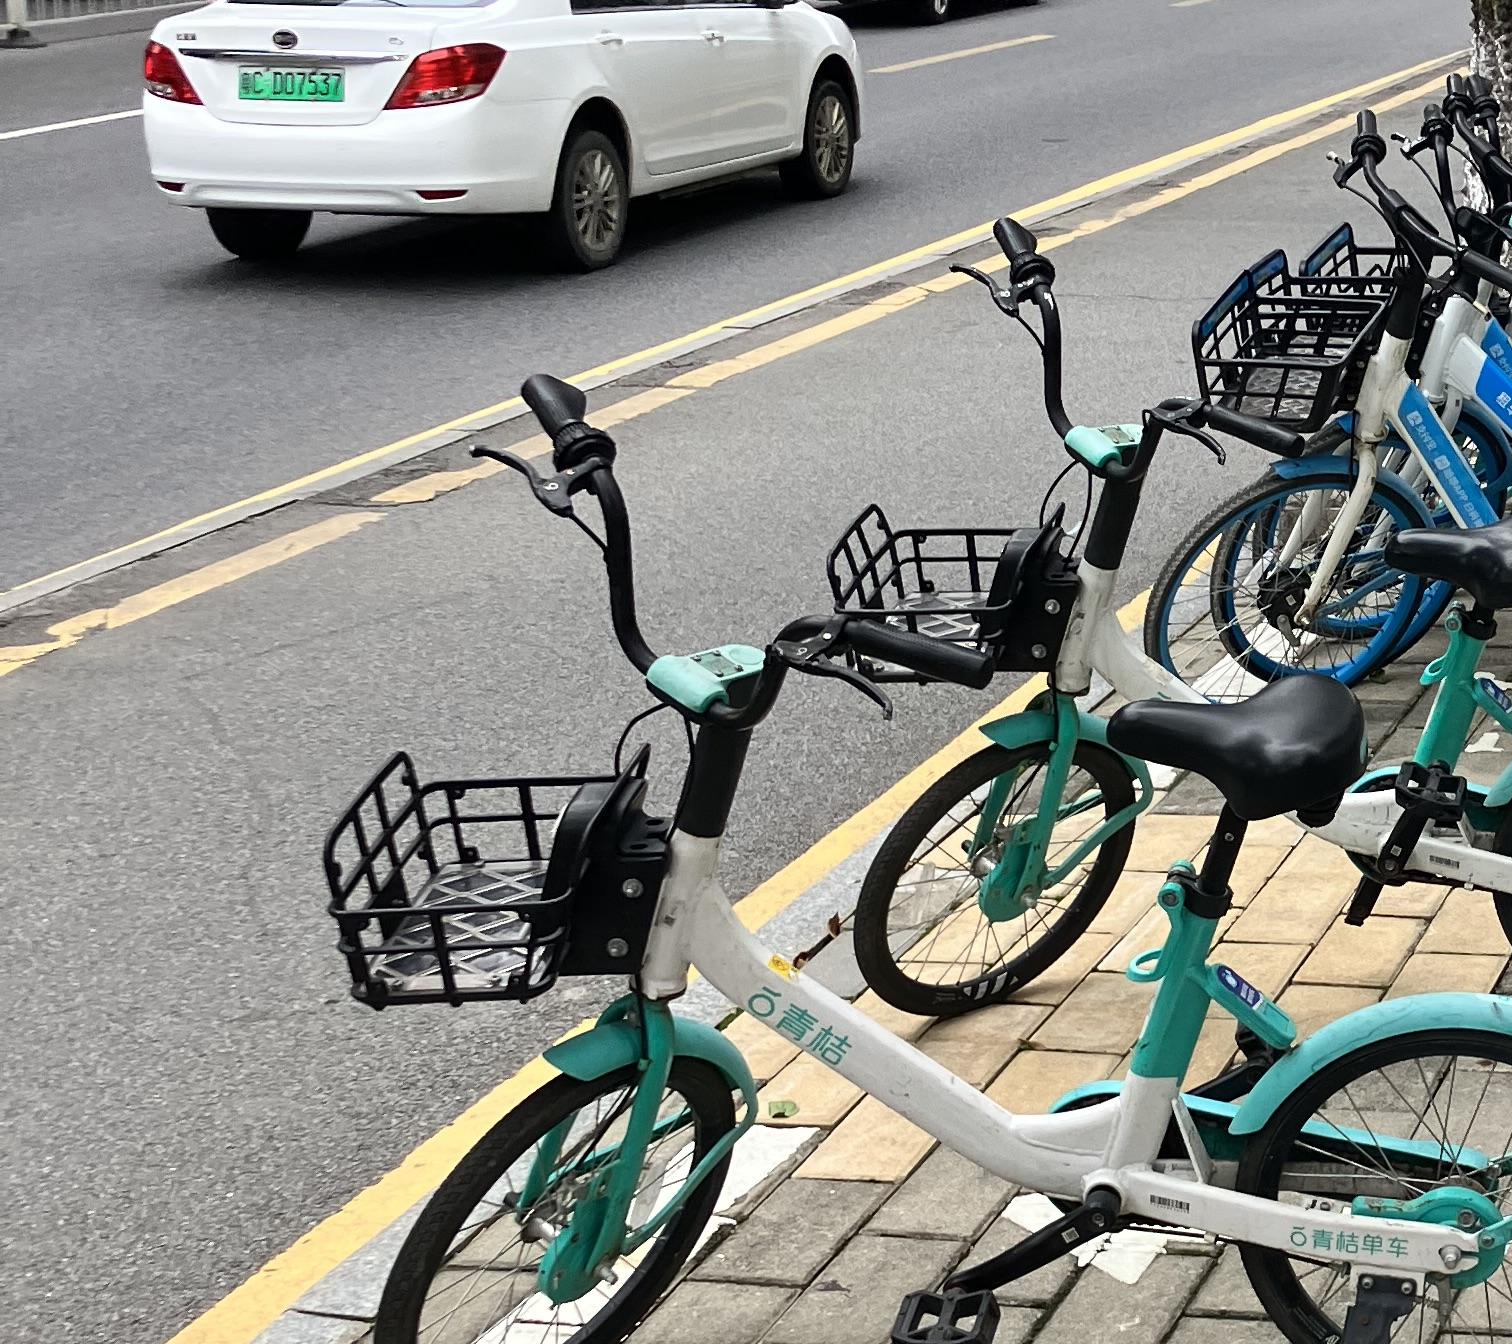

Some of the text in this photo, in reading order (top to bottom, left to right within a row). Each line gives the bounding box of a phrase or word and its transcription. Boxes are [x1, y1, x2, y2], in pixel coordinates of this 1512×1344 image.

[775, 1002, 853, 1066] 青桔
[1311, 1228, 1409, 1258] 青桔单车
